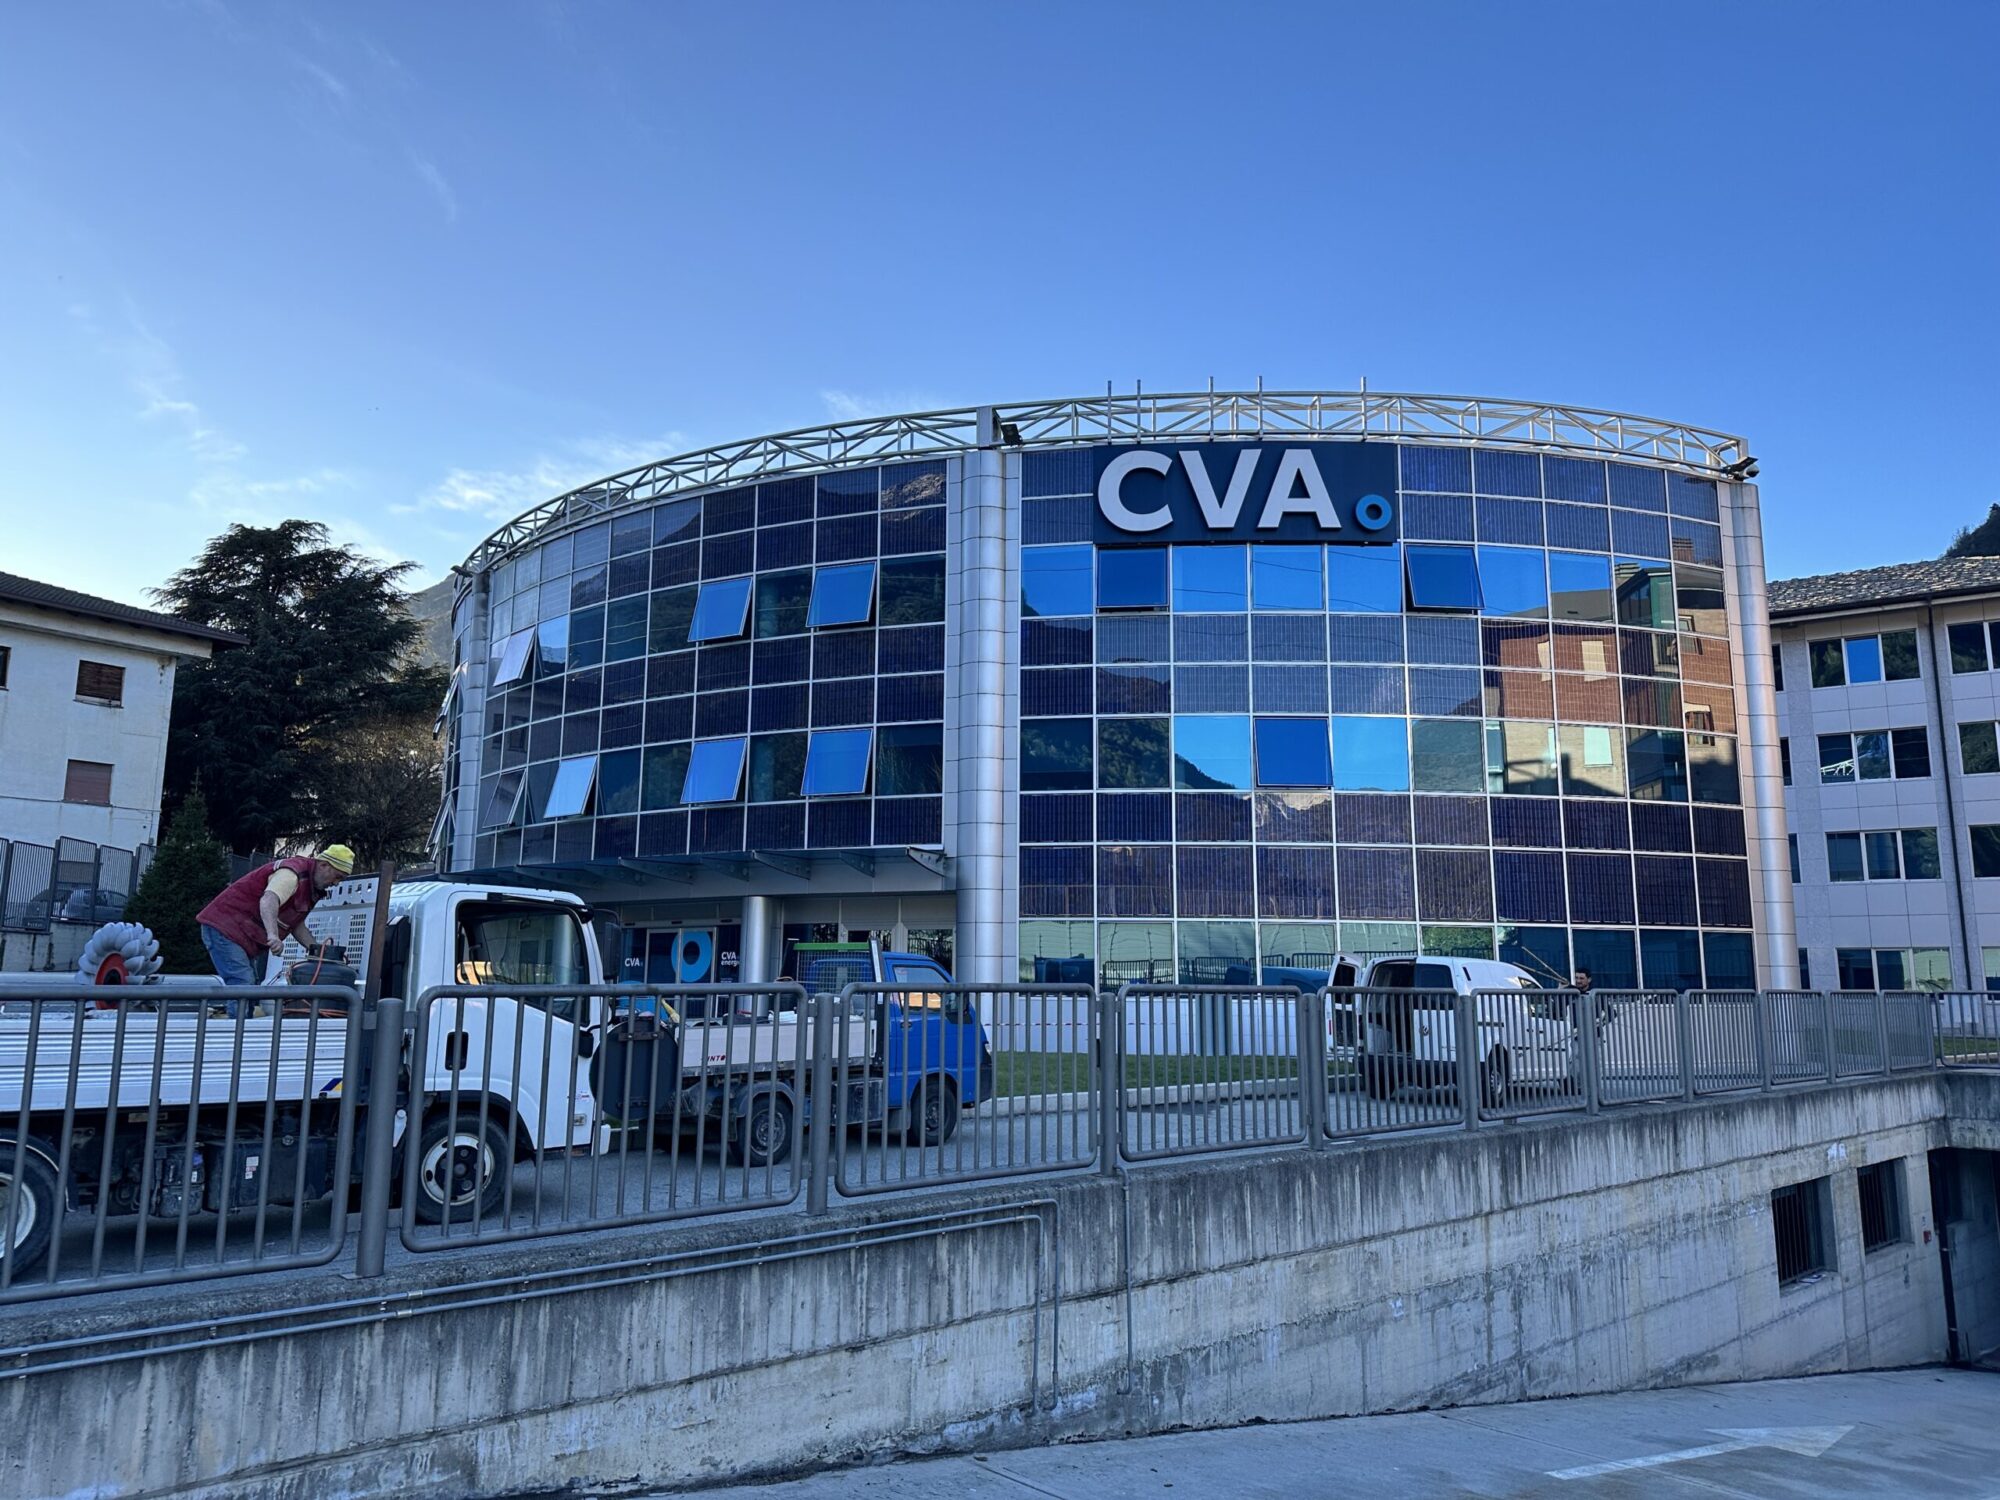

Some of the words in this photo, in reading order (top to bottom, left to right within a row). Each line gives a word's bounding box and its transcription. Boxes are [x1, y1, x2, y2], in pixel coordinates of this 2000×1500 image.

[1098, 449, 1342, 532] CVA
[721, 951, 737, 960] CVA
[624, 957, 641, 967] CVA
